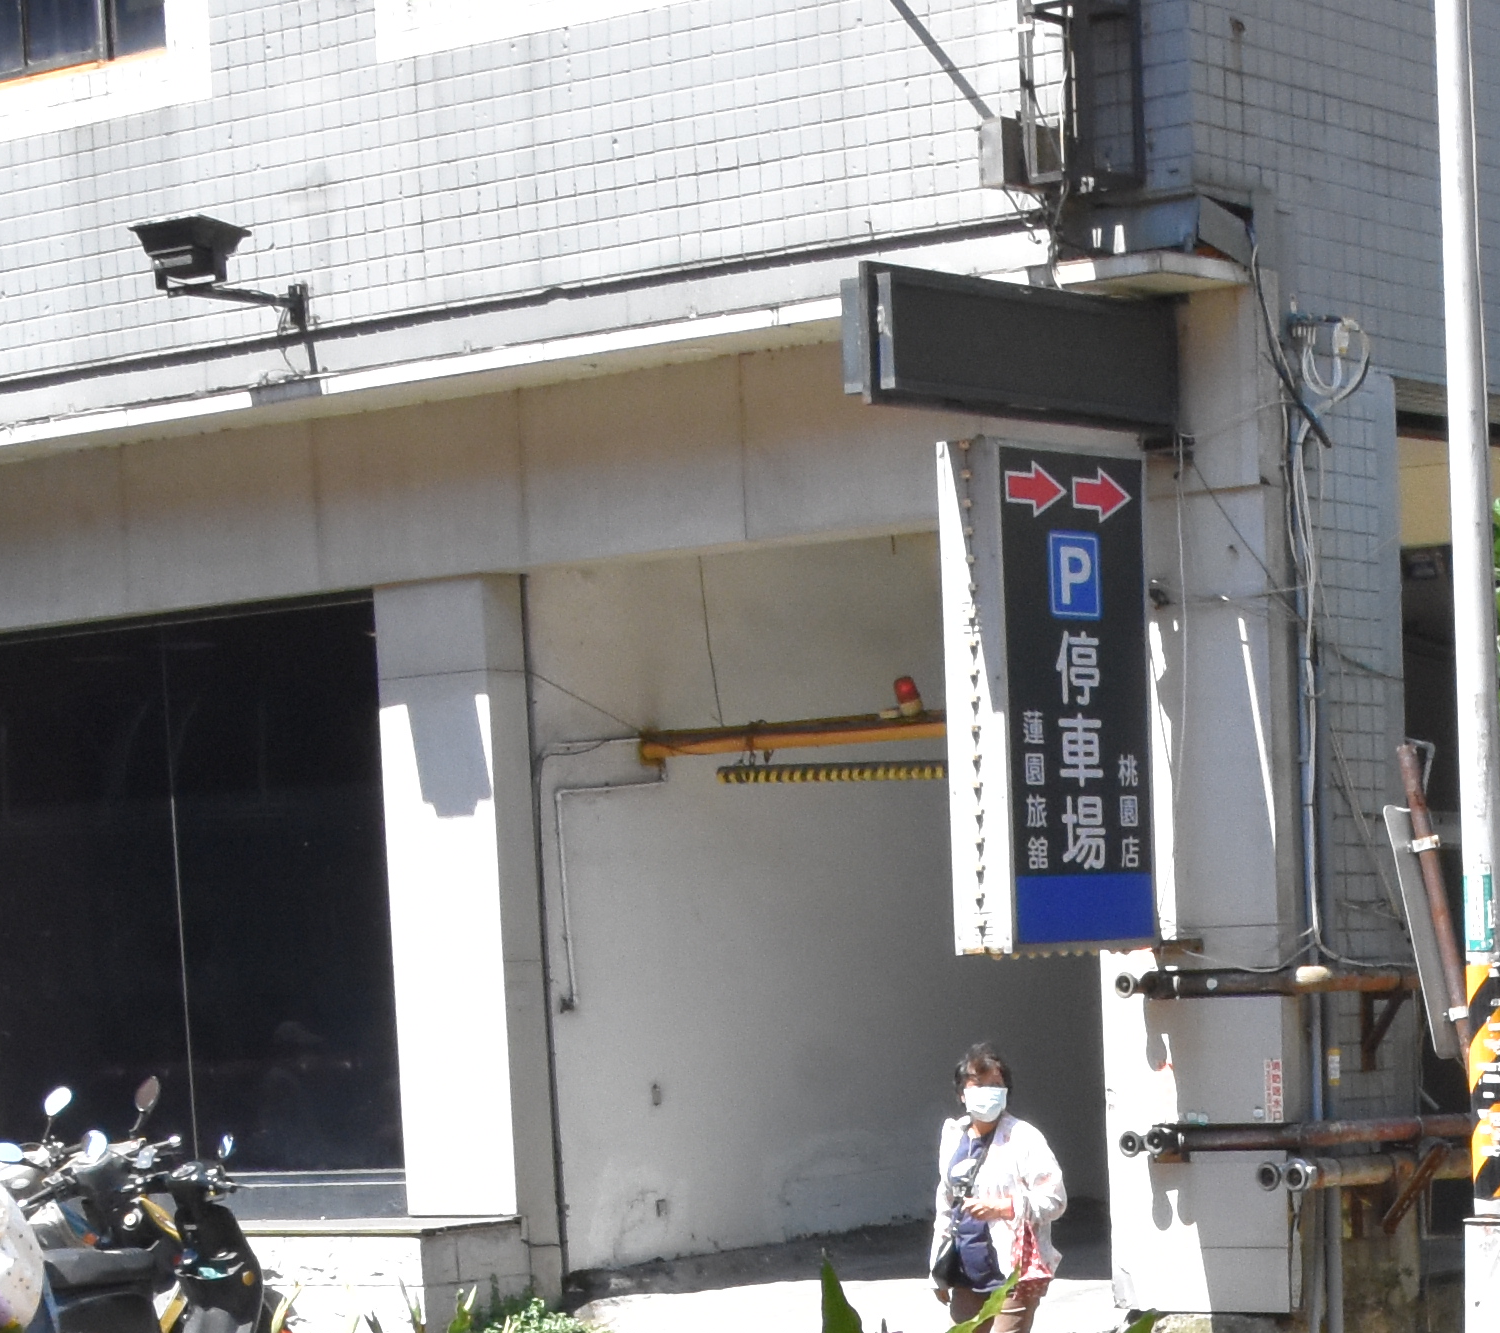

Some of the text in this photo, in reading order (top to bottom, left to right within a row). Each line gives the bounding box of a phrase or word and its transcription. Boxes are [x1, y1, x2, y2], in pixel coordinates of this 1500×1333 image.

[1059, 546, 1092, 605] P
[1055, 630, 1106, 870] 停車場
[1117, 754, 1140, 868] 桃園店
